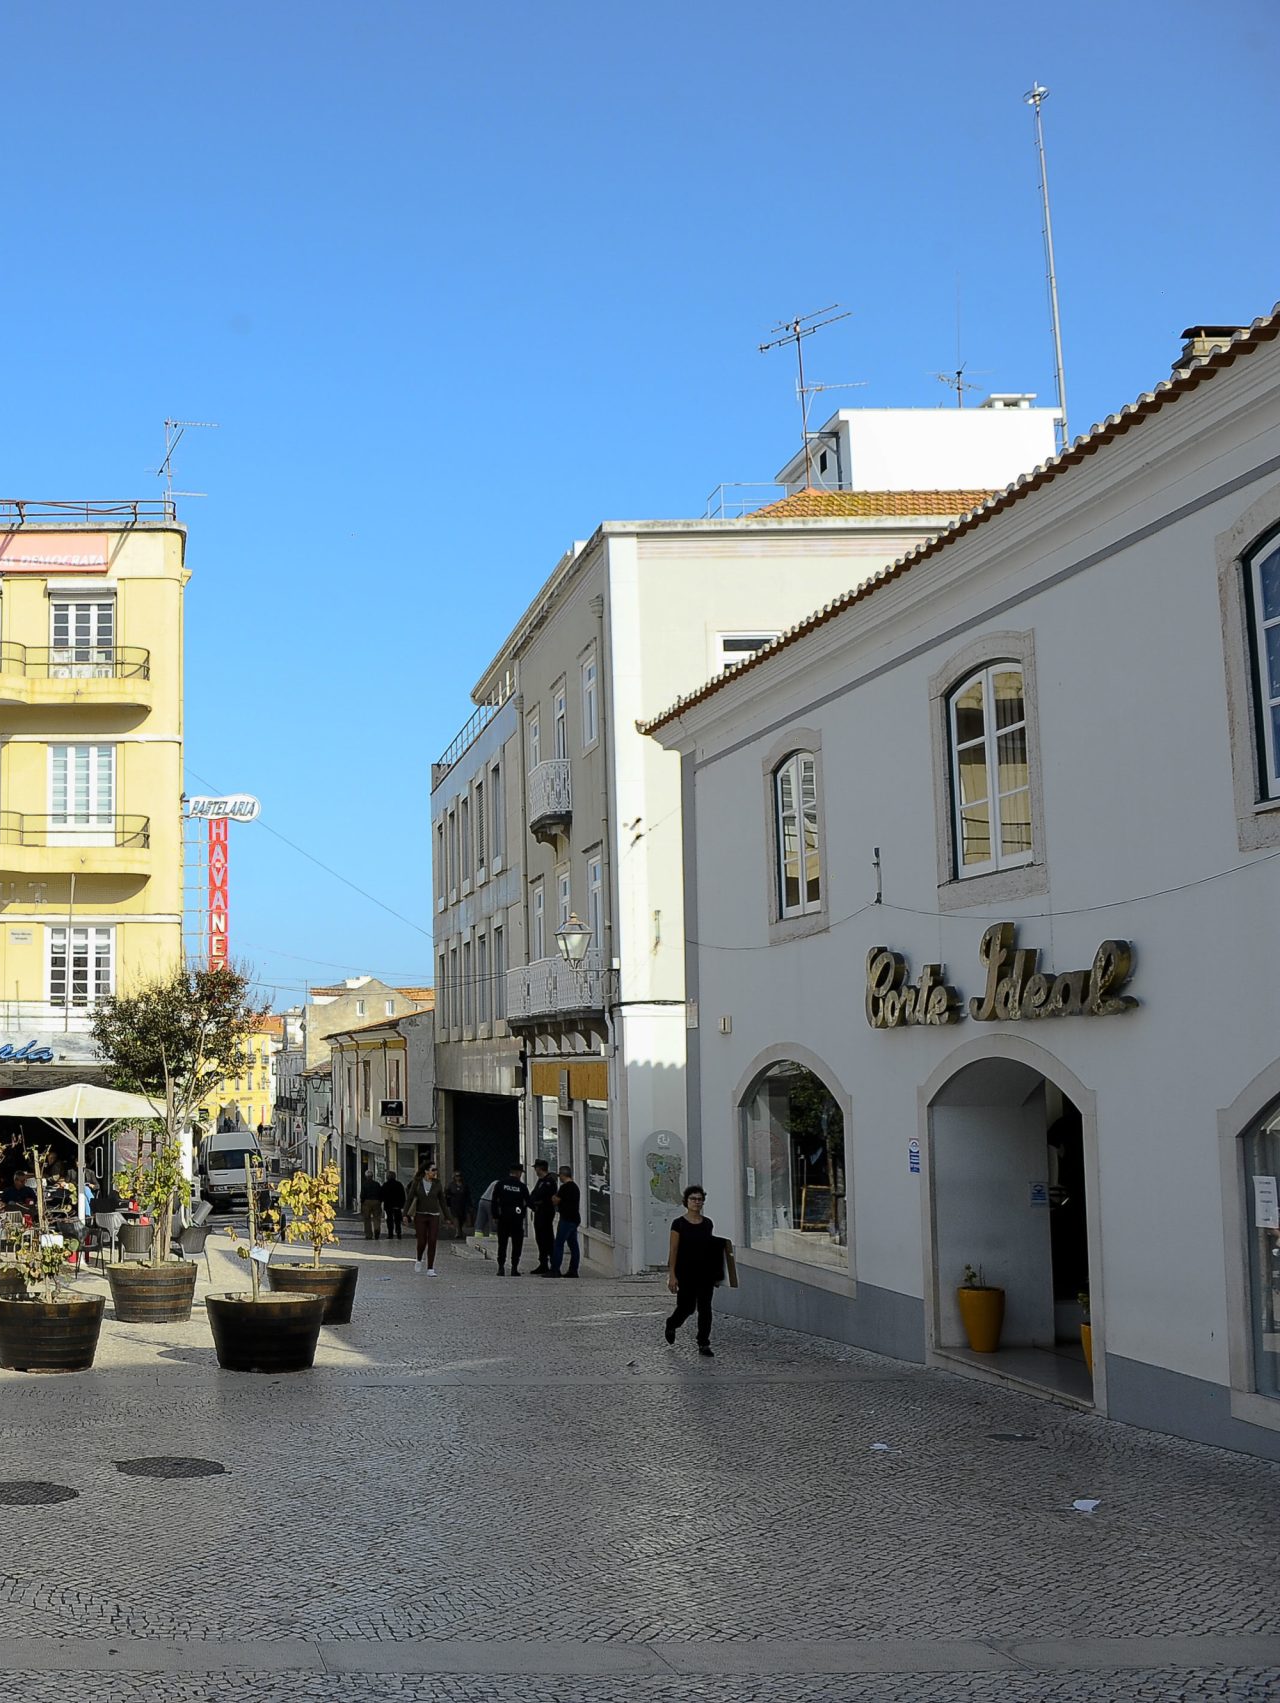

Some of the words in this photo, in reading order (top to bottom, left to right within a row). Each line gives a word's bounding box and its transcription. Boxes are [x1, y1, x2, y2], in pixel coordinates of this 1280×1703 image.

[190, 800, 257, 817] PASTELARIA
[865, 946, 964, 1029] Corte
[970, 921, 1140, 1022] Ideal
